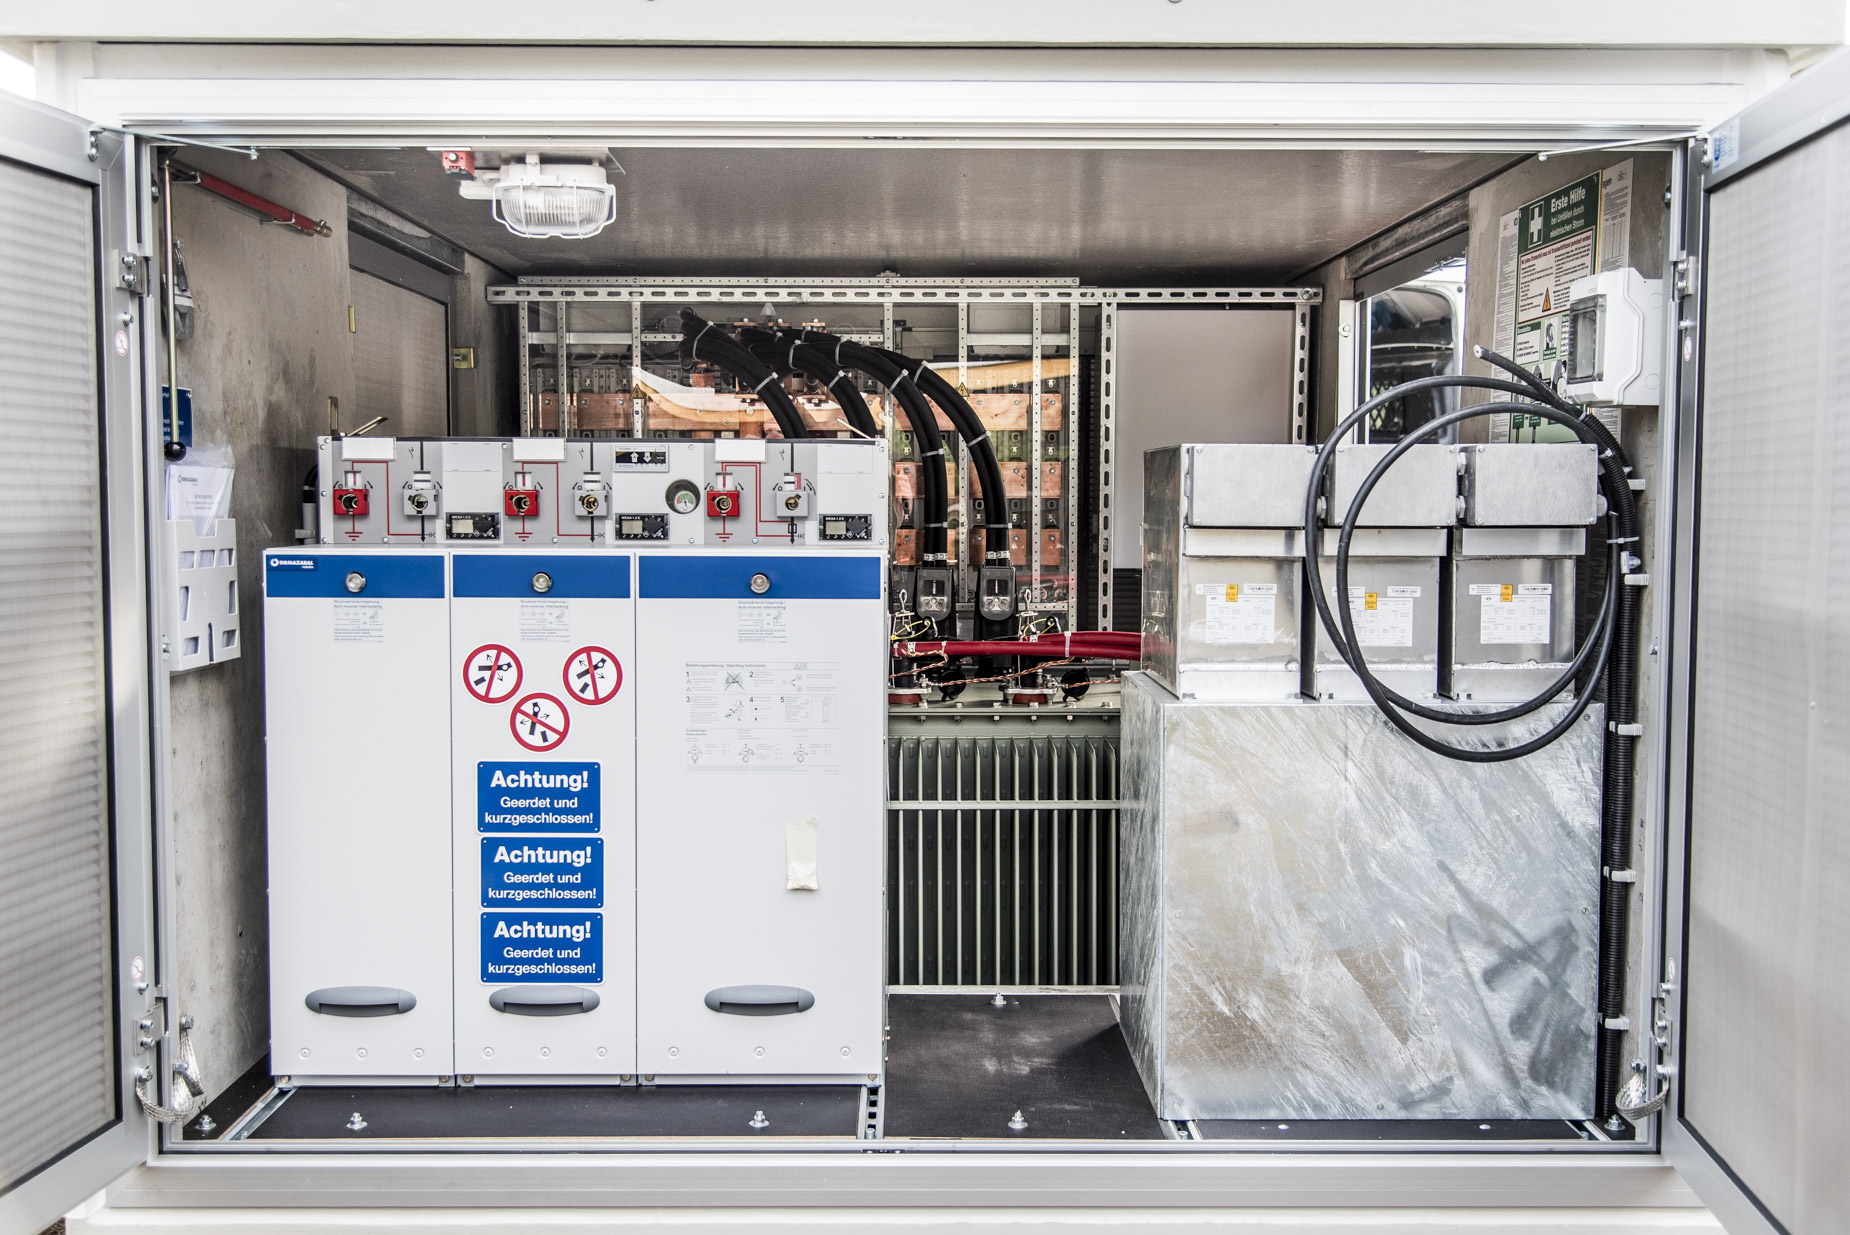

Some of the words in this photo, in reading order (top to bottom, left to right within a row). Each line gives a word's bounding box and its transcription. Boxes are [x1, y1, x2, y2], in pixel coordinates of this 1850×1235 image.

[1551, 195, 1568, 212] Erste
[1570, 186, 1586, 204] Hilfe
[1573, 205, 1584, 216] durch
[1550, 224, 1572, 238] elektrischen
[1573, 219, 1584, 230] Strom
[490, 770, 588, 792] Achtung!
[500, 797, 551, 808] Geerdet
[554, 797, 578, 808] und
[485, 812, 593, 826] kurzgeschlossen!
[494, 846, 592, 867] Achtung!
[504, 872, 554, 883] Geerdet
[557, 872, 581, 883] und
[488, 888, 596, 901] kurzgeschlossen!
[493, 921, 591, 942] Achtung!
[503, 947, 553, 958] Geerdet
[556, 947, 580, 958] und
[488, 963, 596, 976] kurzgeschlossen!
